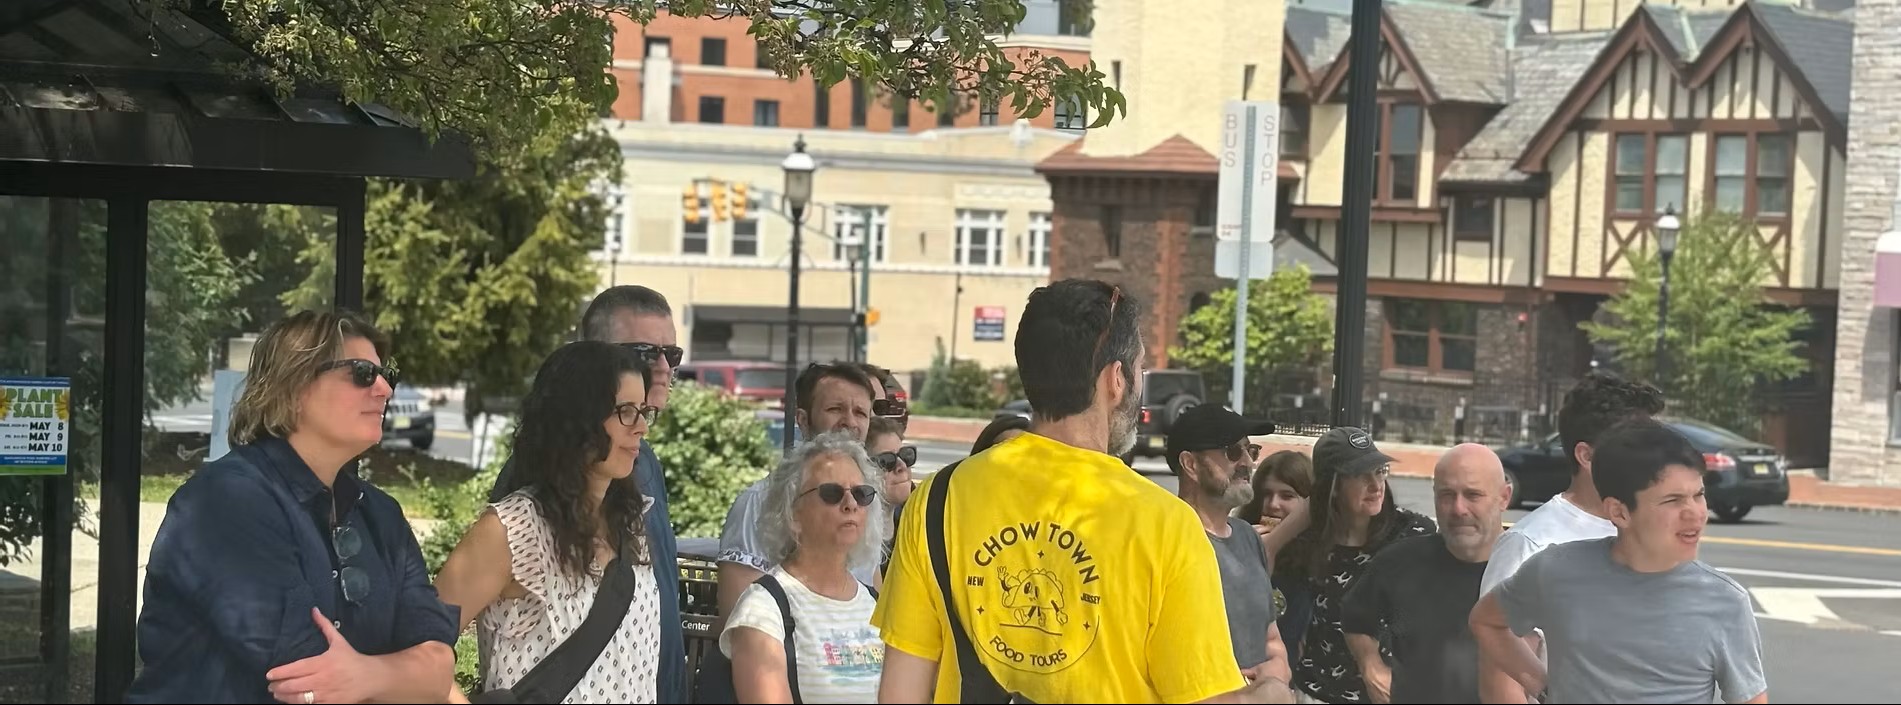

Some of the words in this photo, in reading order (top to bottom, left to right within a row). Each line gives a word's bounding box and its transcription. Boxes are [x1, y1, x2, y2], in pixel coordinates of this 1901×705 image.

[1225, 113, 1237, 168] BUS
[1261, 115, 1275, 186] STOP
[6, 388, 63, 403] PLANT
[13, 403, 53, 418] SALE
[30, 422, 51, 430] MAY
[57, 422, 64, 431] 8
[29, 432, 50, 441] MAY
[57, 432, 63, 441] 9
[28, 443, 50, 451] MAY
[52, 443, 63, 452] 10
[974, 521, 1041, 567] CHOW
[1048, 522, 1100, 585] TOWN
[967, 575, 984, 587] NEW
[1080, 592, 1101, 605] JERSEY
[681, 620, 710, 631] Center
[989, 635, 1025, 663] FOOD
[1029, 649, 1068, 667] TOURS
